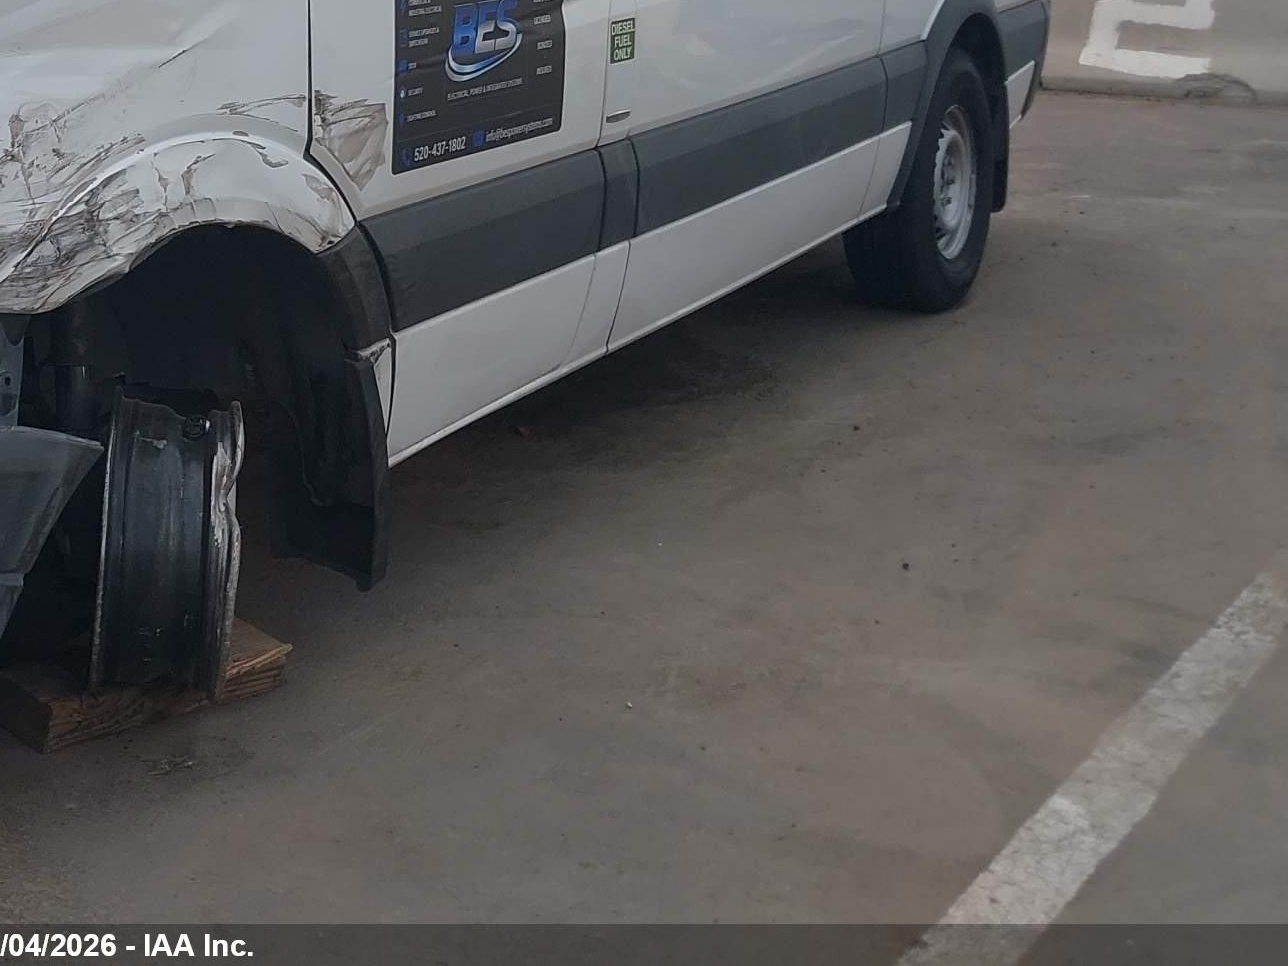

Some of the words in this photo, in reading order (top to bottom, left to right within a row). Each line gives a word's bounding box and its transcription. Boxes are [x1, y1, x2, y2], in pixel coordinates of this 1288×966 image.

[612, 20, 635, 35] DIESEL
[614, 34, 632, 48] FUEL
[613, 47, 632, 61] ONLY
[414, 136, 467, 162] 520-437-1802
